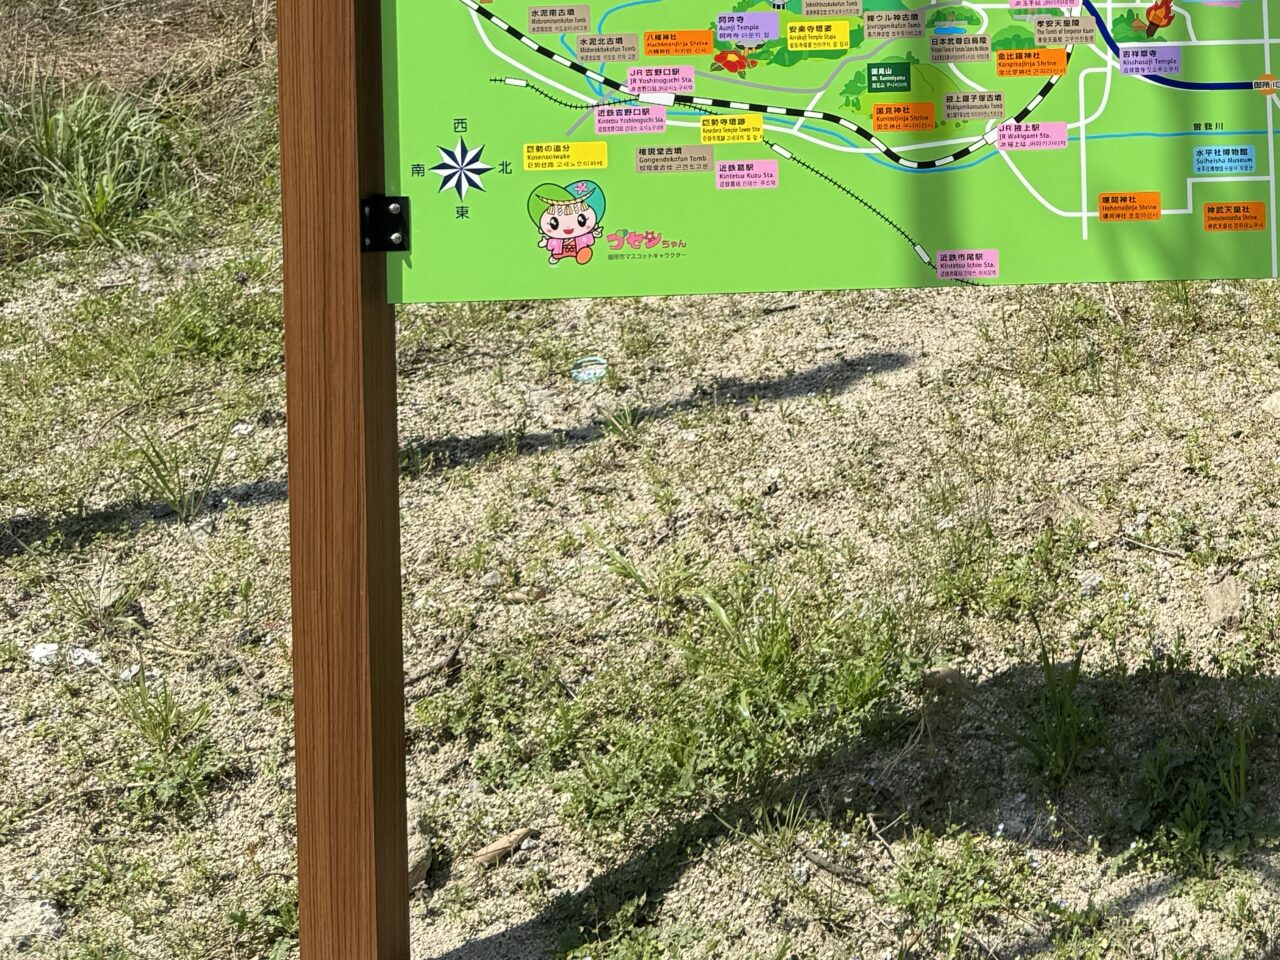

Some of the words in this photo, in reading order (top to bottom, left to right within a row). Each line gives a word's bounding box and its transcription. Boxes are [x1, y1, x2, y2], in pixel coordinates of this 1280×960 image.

[736, 24, 759, 32] Temple
[621, 45, 635, 53] Tomb
[1036, 59, 1057, 67] Shrine
[1154, 57, 1177, 66] Temple
[630, 68, 643, 76] JR
[645, 67, 680, 76] 吉野口駅
[637, 76, 680, 85] Yoshinoguchi
[909, 114, 929, 122] Shrine
[453, 119, 468, 133] 西
[999, 124, 1012, 132] JR
[1007, 132, 1038, 141] Wakigami
[639, 155, 688, 164] Gongendokofun
[1228, 156, 1253, 164] Museum
[411, 163, 425, 177] 南
[498, 161, 512, 175] 北
[719, 172, 745, 180] Kintetsu
[746, 172, 762, 180] Kuzu
[763, 171, 774, 179] Sta.
[1138, 203, 1157, 211] Shrine
[455, 205, 470, 220] 東
[983, 261, 996, 269] Sta.
